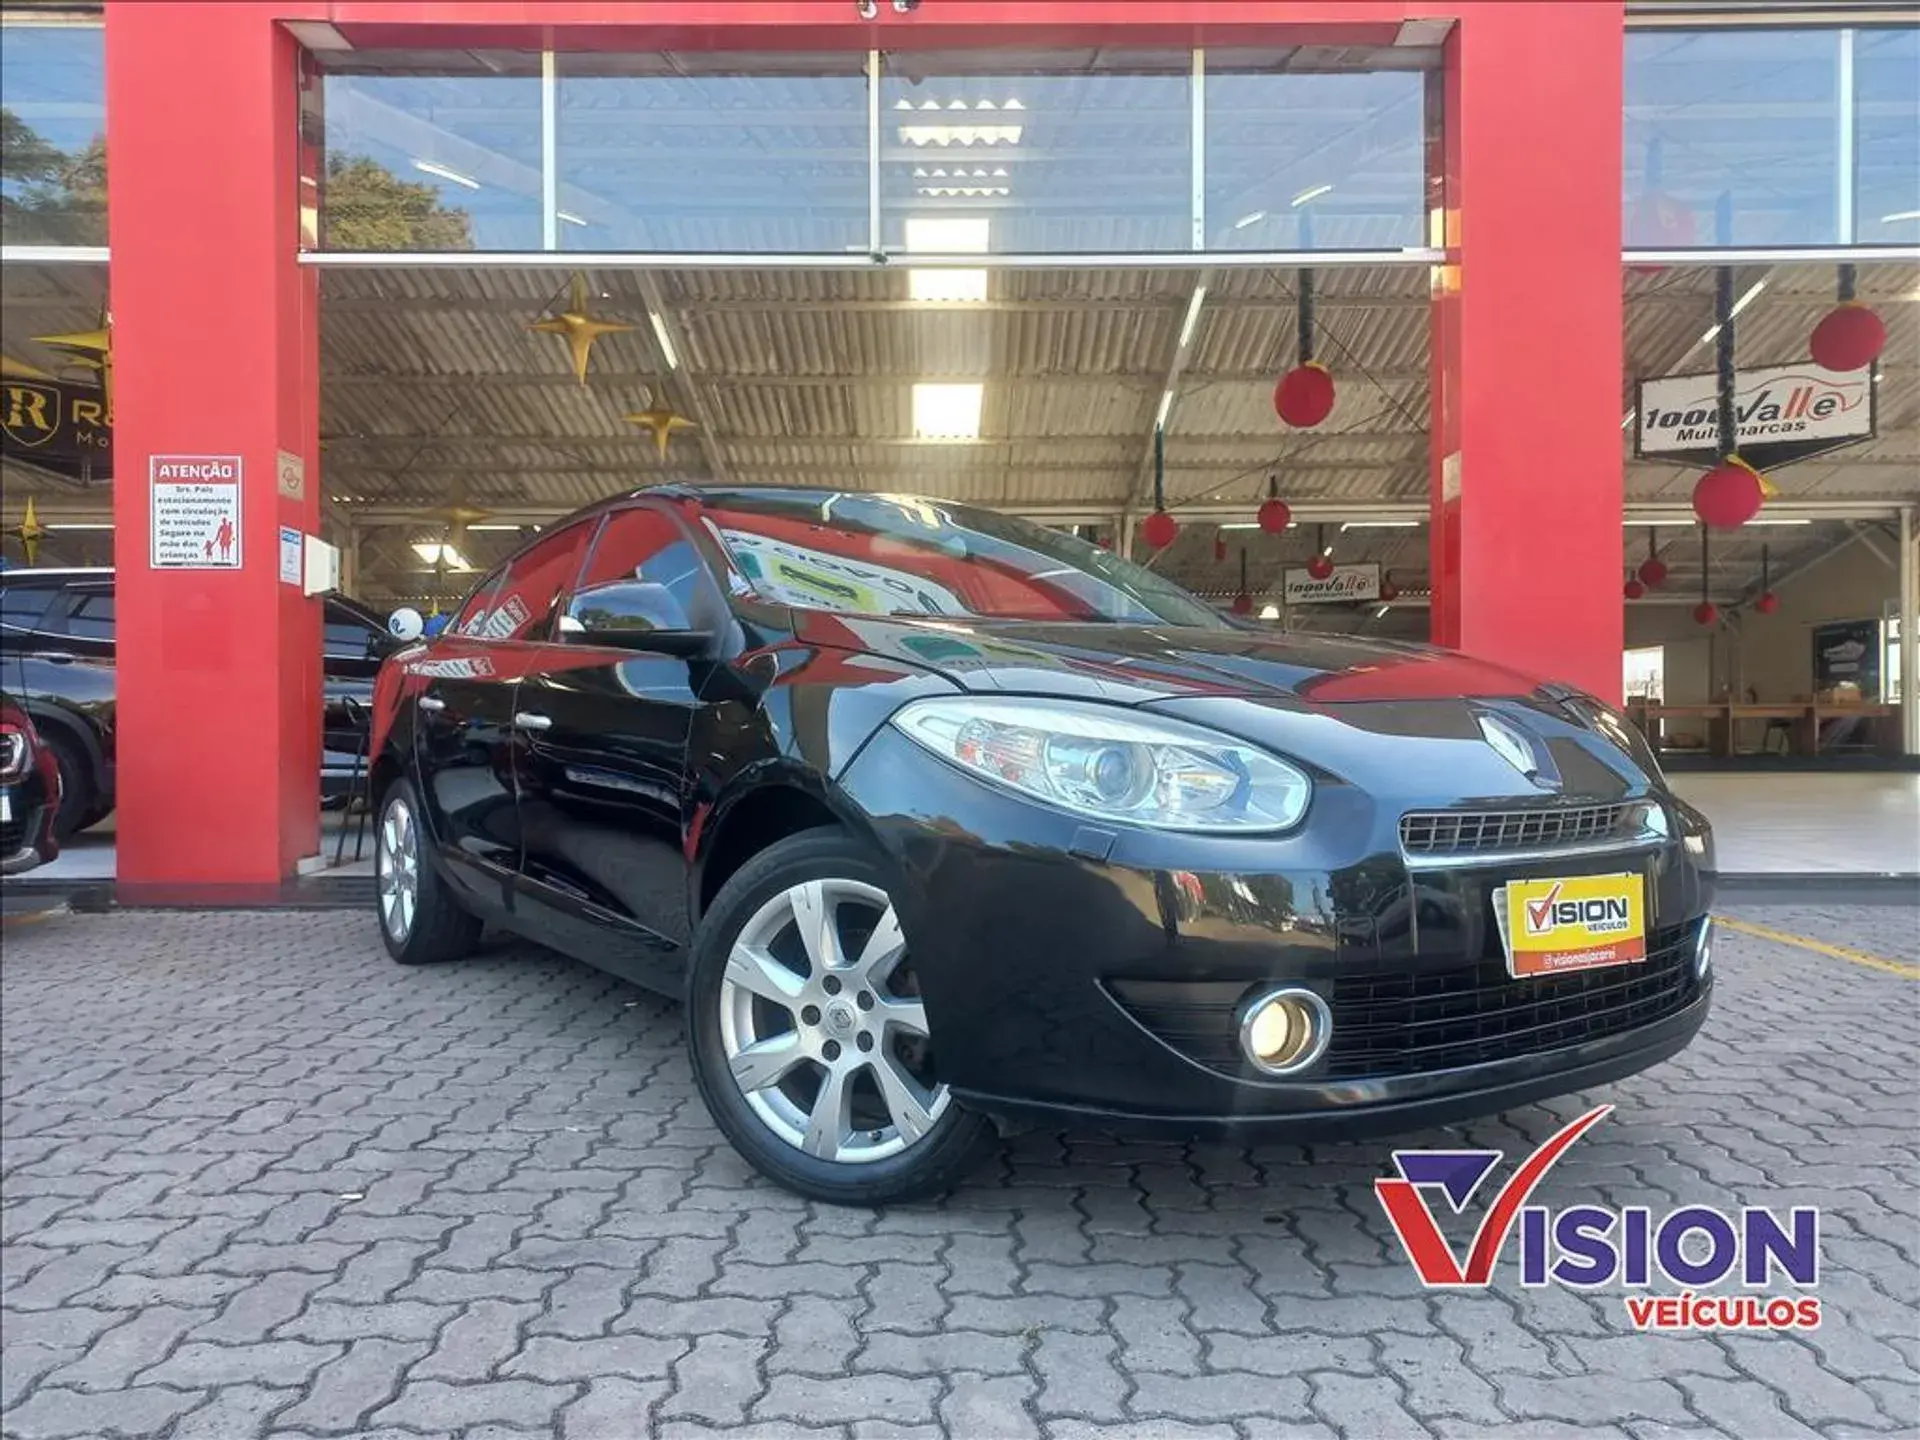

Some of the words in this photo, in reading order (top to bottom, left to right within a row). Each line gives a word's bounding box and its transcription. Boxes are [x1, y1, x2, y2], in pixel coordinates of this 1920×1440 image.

[1676, 420, 1806, 441] Mulmarcas
[159, 461, 233, 481] ATENÇÃO
[1526, 882, 1628, 932] VISION
